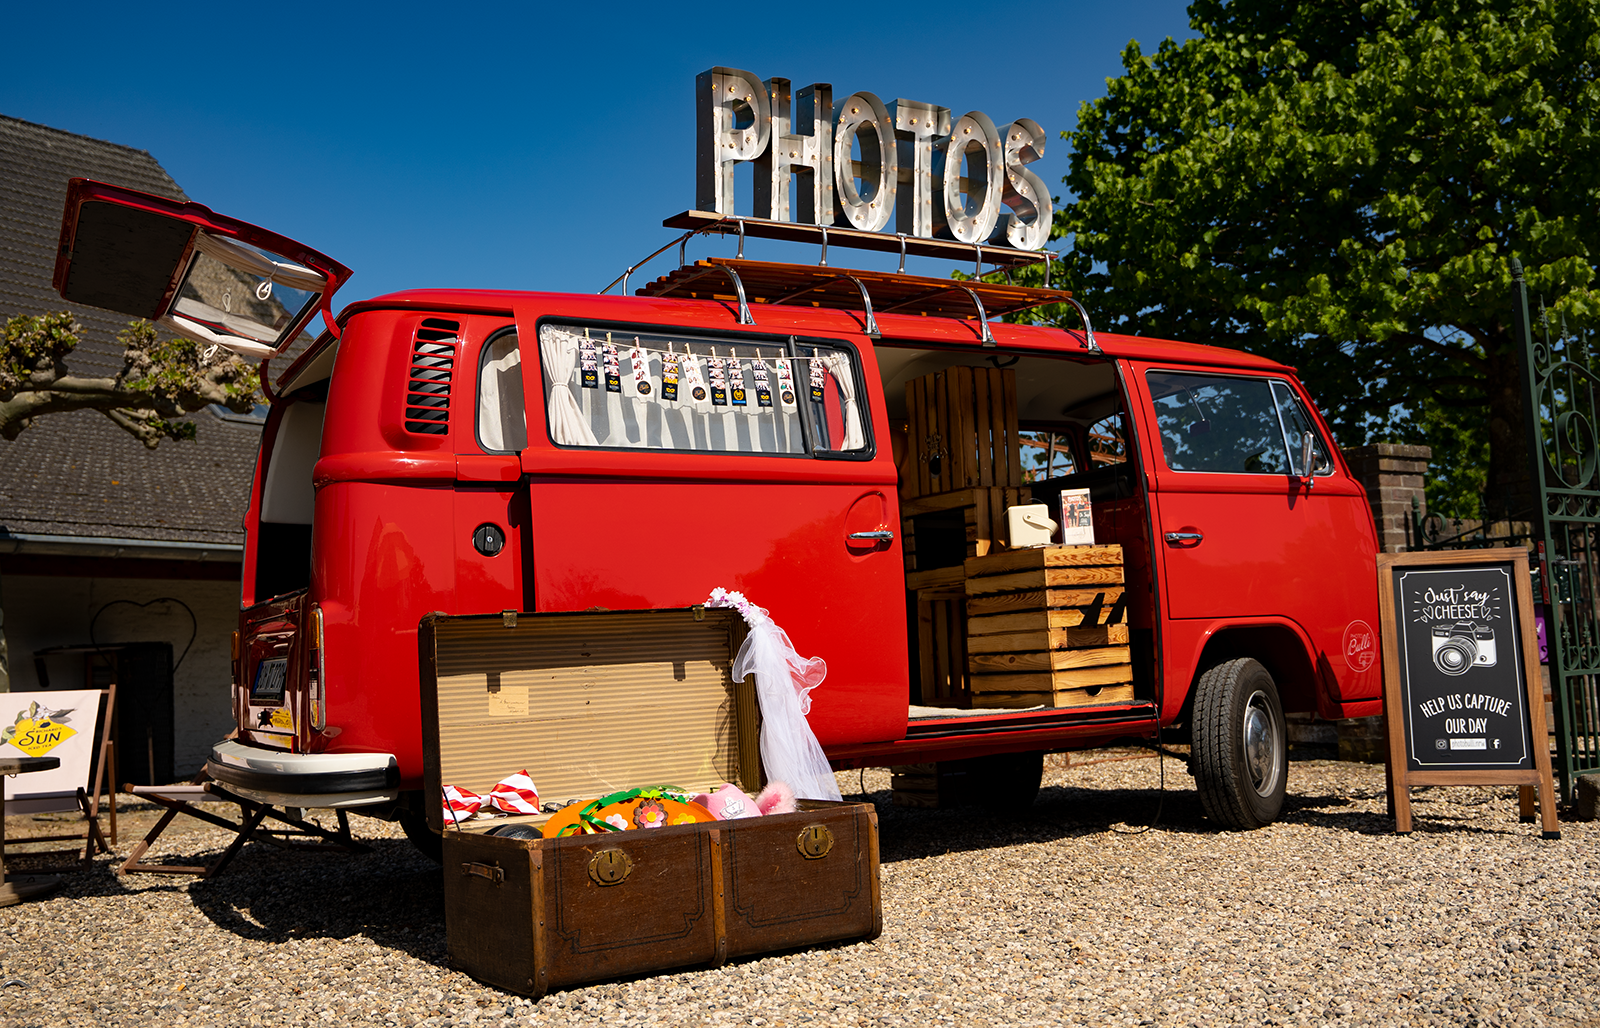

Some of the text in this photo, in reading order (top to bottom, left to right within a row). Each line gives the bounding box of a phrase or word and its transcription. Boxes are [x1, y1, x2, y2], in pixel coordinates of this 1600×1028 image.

[696, 66, 1053, 250] PHOTOS
[1424, 584, 1490, 606] Just say
[1434, 604, 1480, 620] CHEESE
[1347, 632, 1372, 656] Bulli
[1419, 693, 1512, 718] HELP US CAPTURE
[1445, 717, 1488, 734] OUR DAY
[18, 730, 61, 747] SUN
